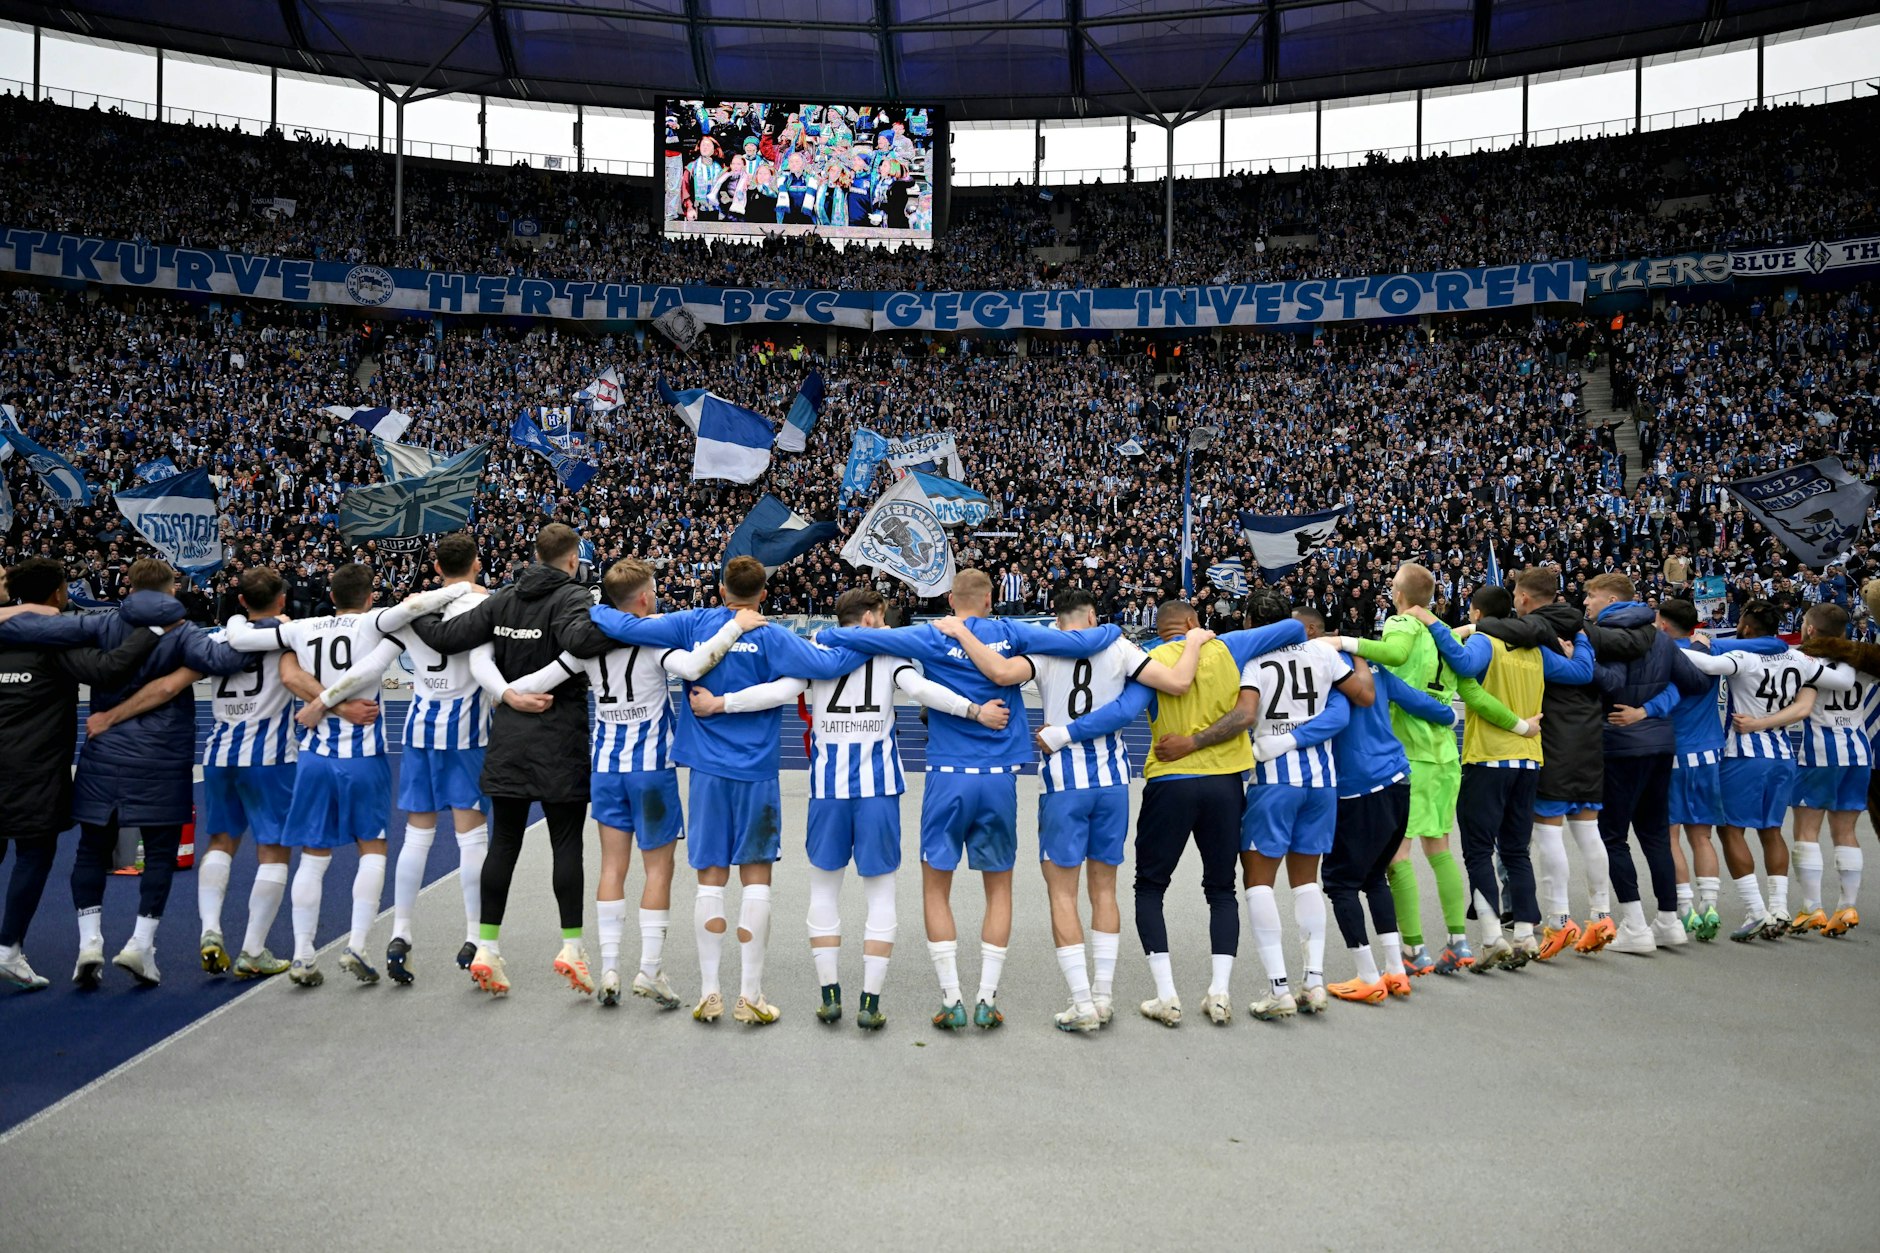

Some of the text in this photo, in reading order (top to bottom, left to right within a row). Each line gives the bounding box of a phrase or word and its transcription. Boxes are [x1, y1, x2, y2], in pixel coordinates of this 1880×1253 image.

[351, 267, 390, 282] OSTKURVE
[1588, 254, 1733, 293] 71ERS
[1731, 252, 1796, 271] BLUE
[350, 287, 391, 304] HERTHA BSC
[425, 260, 1576, 330] HERTHA BSC GEGEN INVESTOREN
[1751, 475, 1805, 496] 1892
[1068, 658, 1093, 720] 8
[1260, 659, 1318, 719] 24
[1756, 667, 1801, 713] 40
[225, 702, 257, 716] TOUSART
